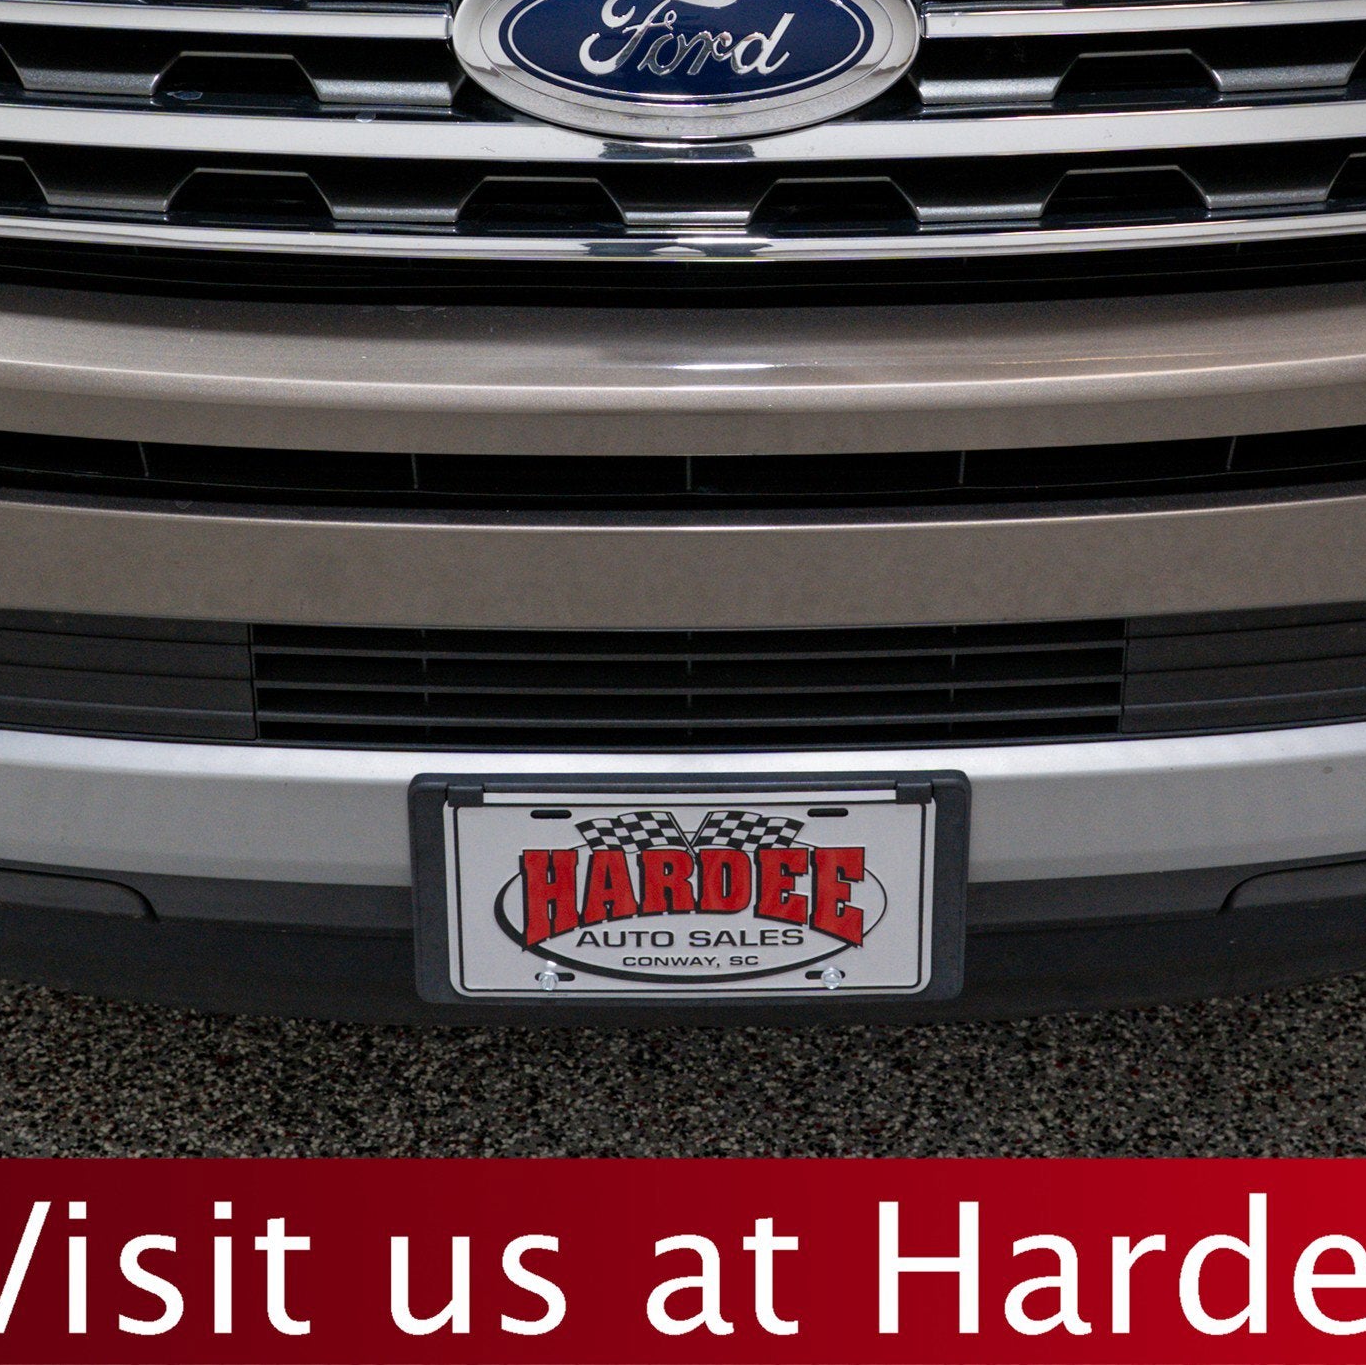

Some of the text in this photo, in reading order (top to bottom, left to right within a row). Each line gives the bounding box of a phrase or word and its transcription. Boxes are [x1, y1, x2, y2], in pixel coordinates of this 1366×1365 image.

[519, 846, 866, 950] HARDEE
[576, 928, 805, 948] AUTO SALES
[622, 955, 759, 969] CONWAY, SC
